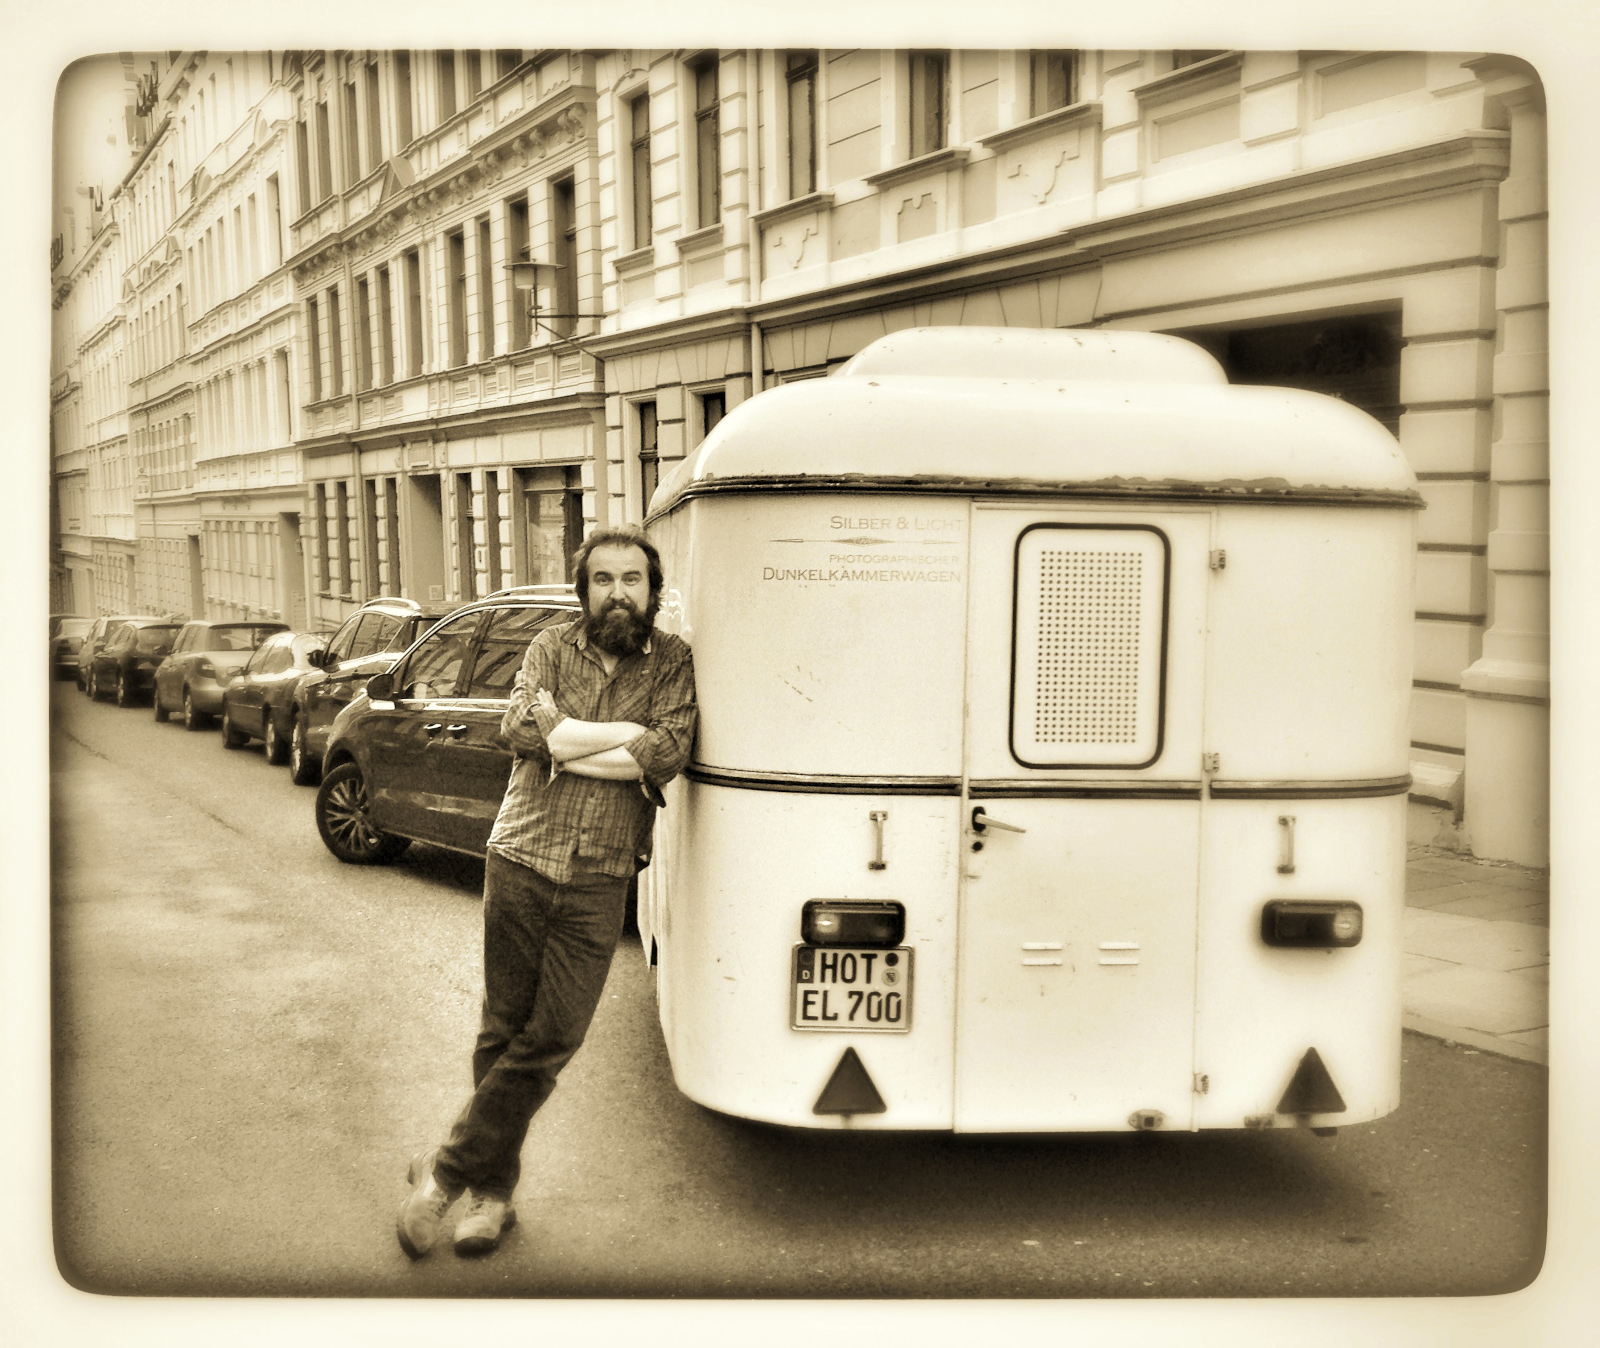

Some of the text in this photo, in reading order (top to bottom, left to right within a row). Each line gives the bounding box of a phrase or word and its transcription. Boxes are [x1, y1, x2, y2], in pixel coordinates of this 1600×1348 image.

[830, 515, 964, 532] SILBER & LICHT
[829, 554, 959, 565] PHOTOGRAPHISCHER
[763, 567, 961, 582] DUNKELKAMMERWAGEN
[802, 969, 810, 980] D
[820, 952, 878, 984] HOT
[802, 990, 902, 1022] EL 700
